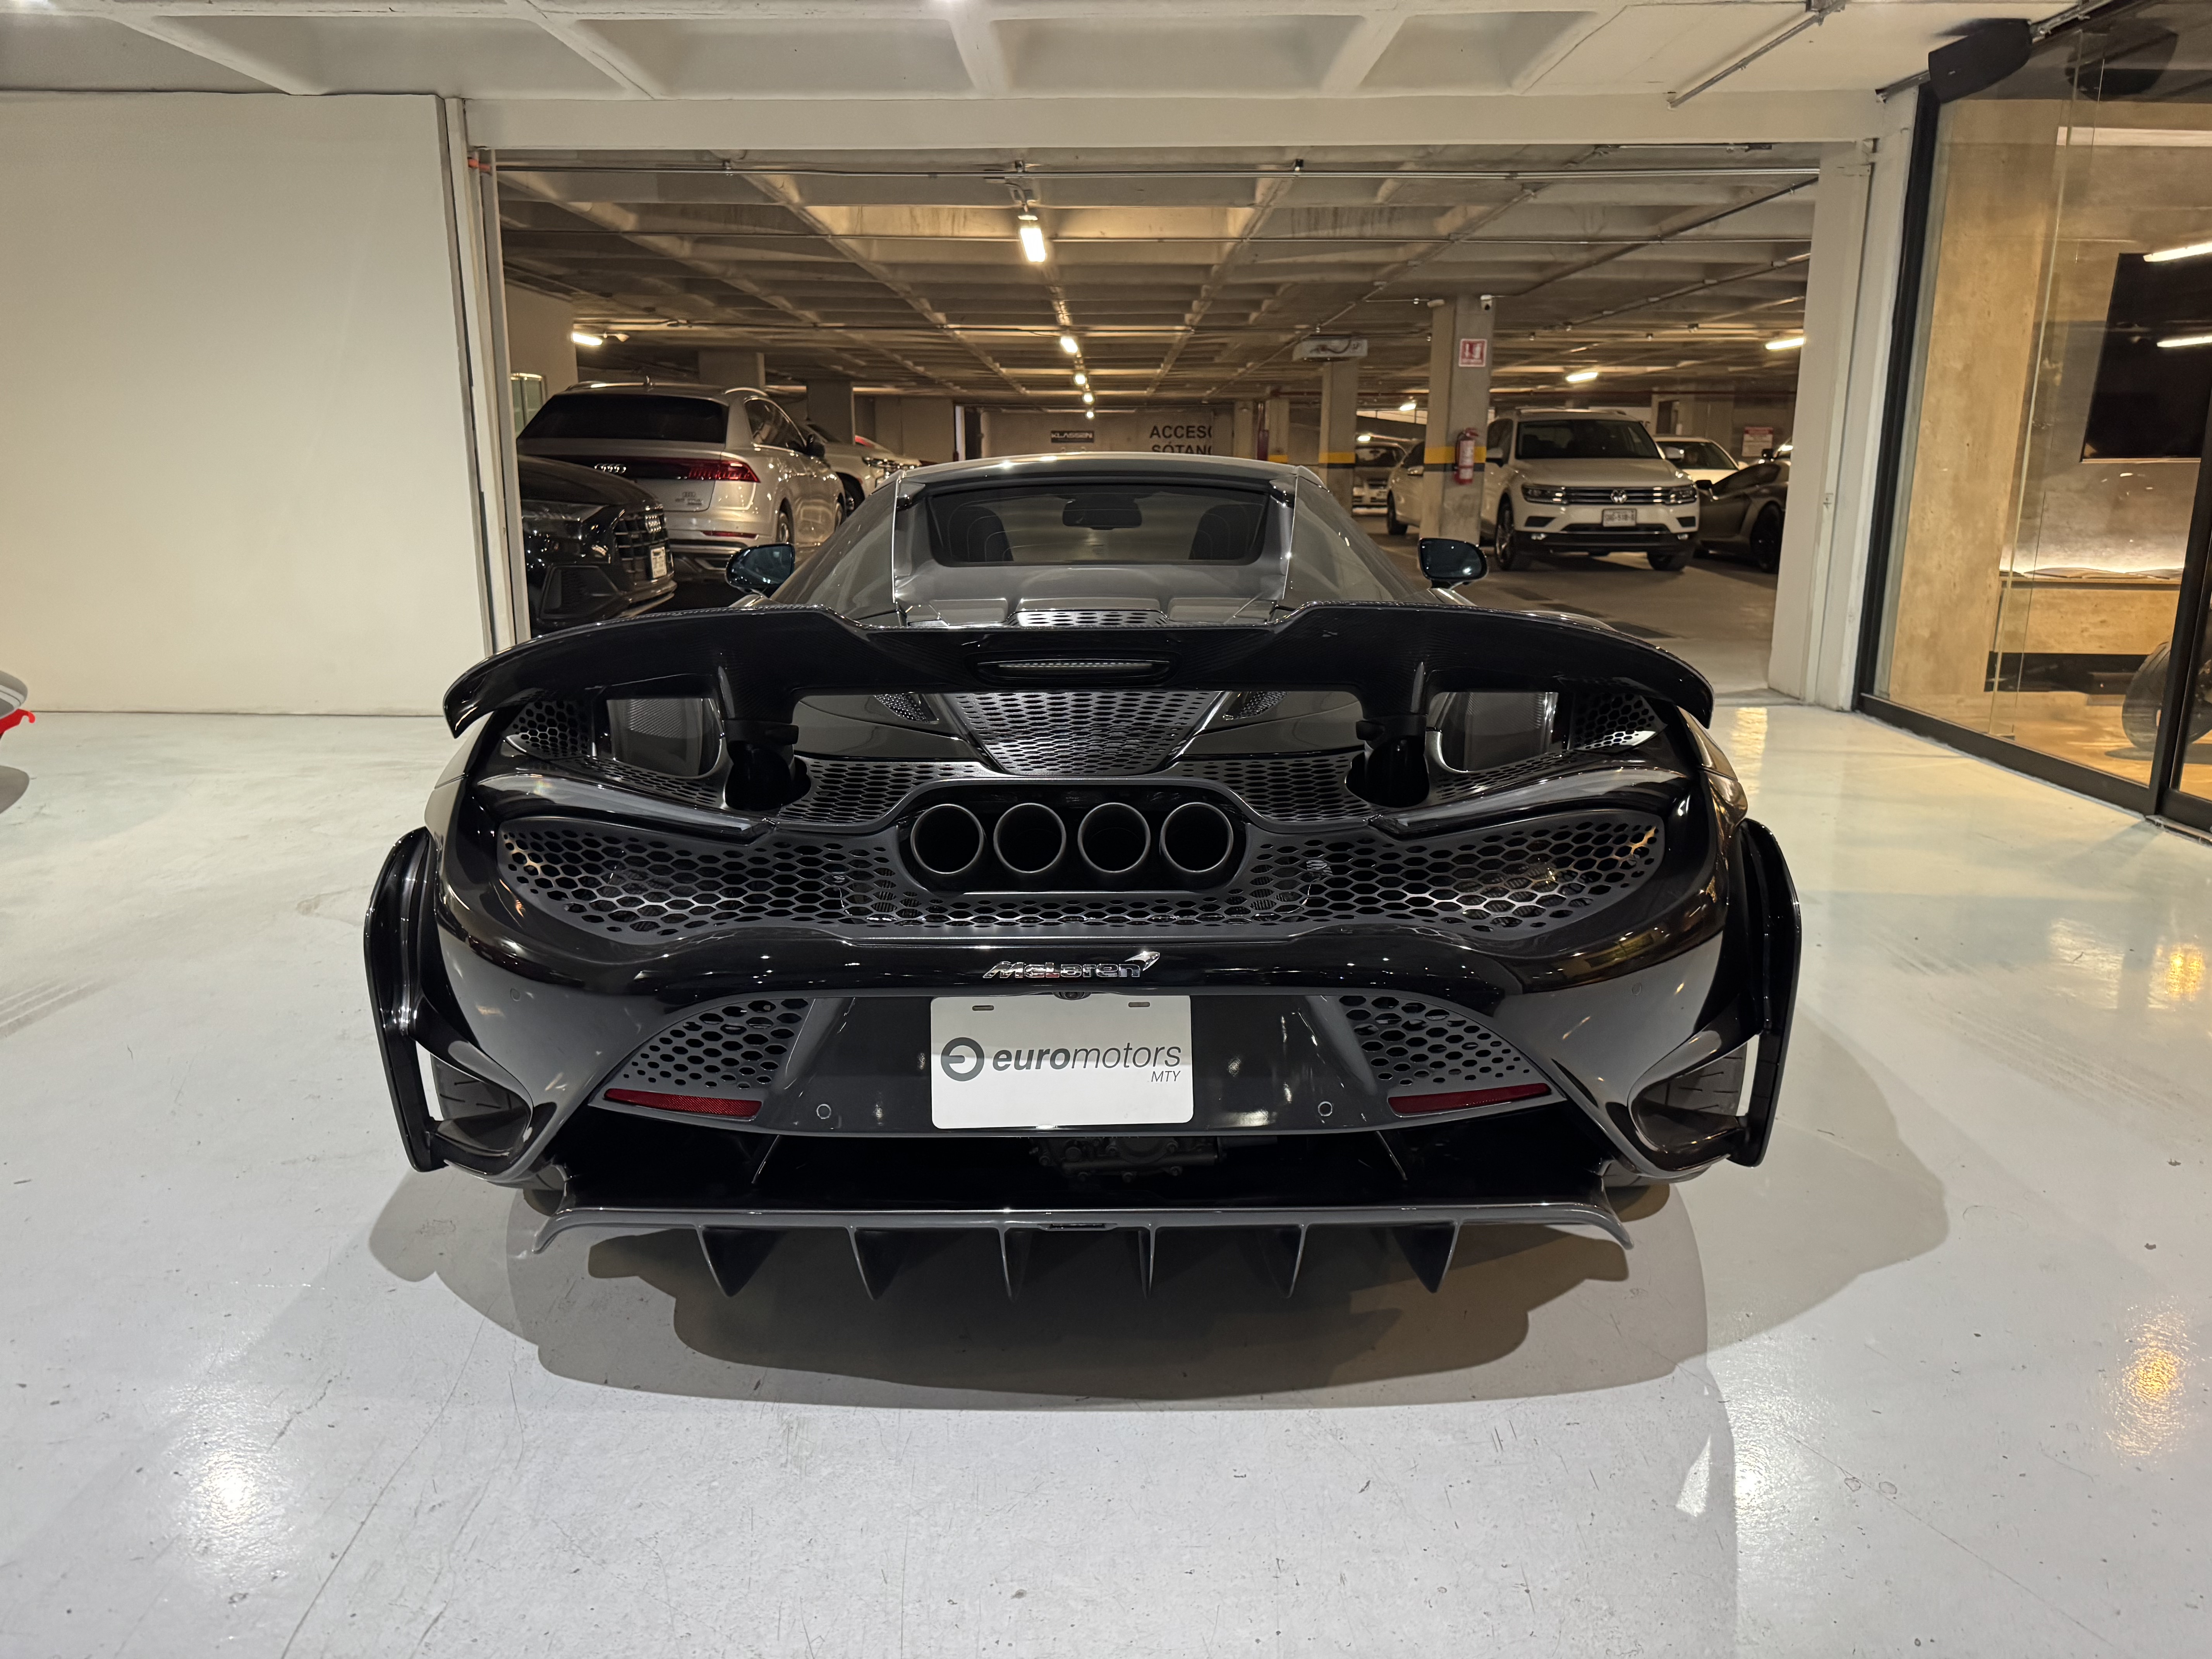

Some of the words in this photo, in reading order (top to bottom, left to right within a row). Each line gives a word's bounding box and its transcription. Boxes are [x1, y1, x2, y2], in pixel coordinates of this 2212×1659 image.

[983, 961, 1140, 978] McLaren
[993, 1042, 1181, 1071] euromotors
[1151, 1070, 1180, 1082] MTY
